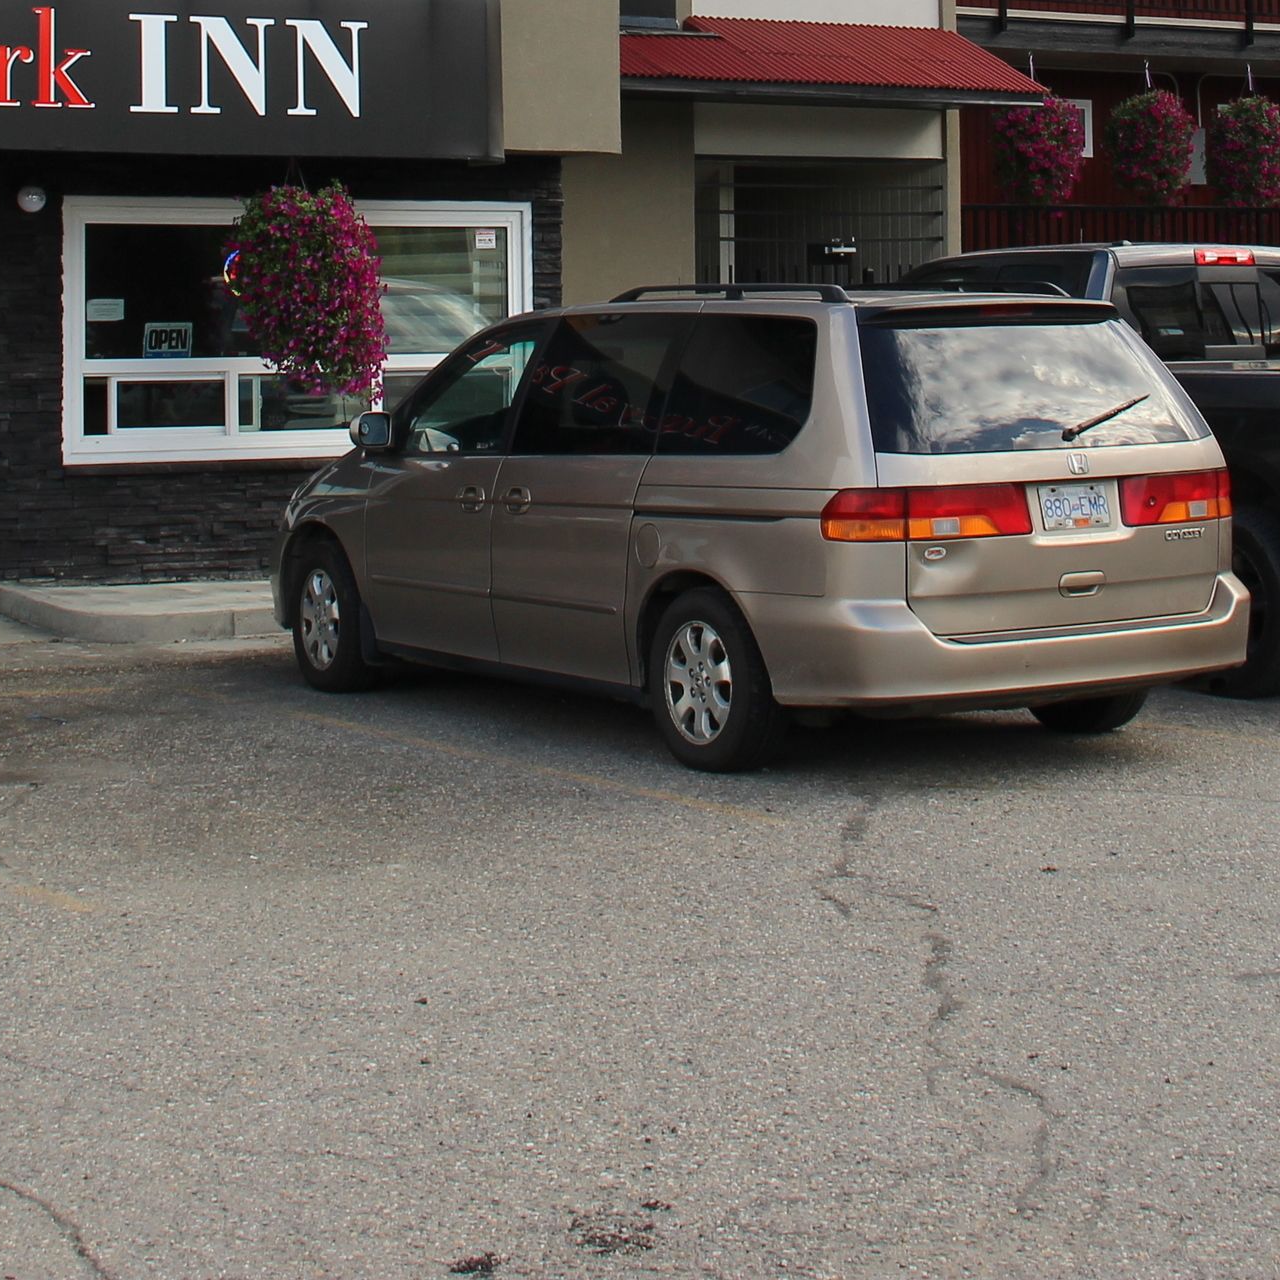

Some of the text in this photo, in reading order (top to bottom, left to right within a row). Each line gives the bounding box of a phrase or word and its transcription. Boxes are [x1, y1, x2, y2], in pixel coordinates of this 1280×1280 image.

[128, 13, 368, 118] INN
[148, 327, 188, 350] OPEN
[1165, 527, 1206, 541] ODYSSEY
